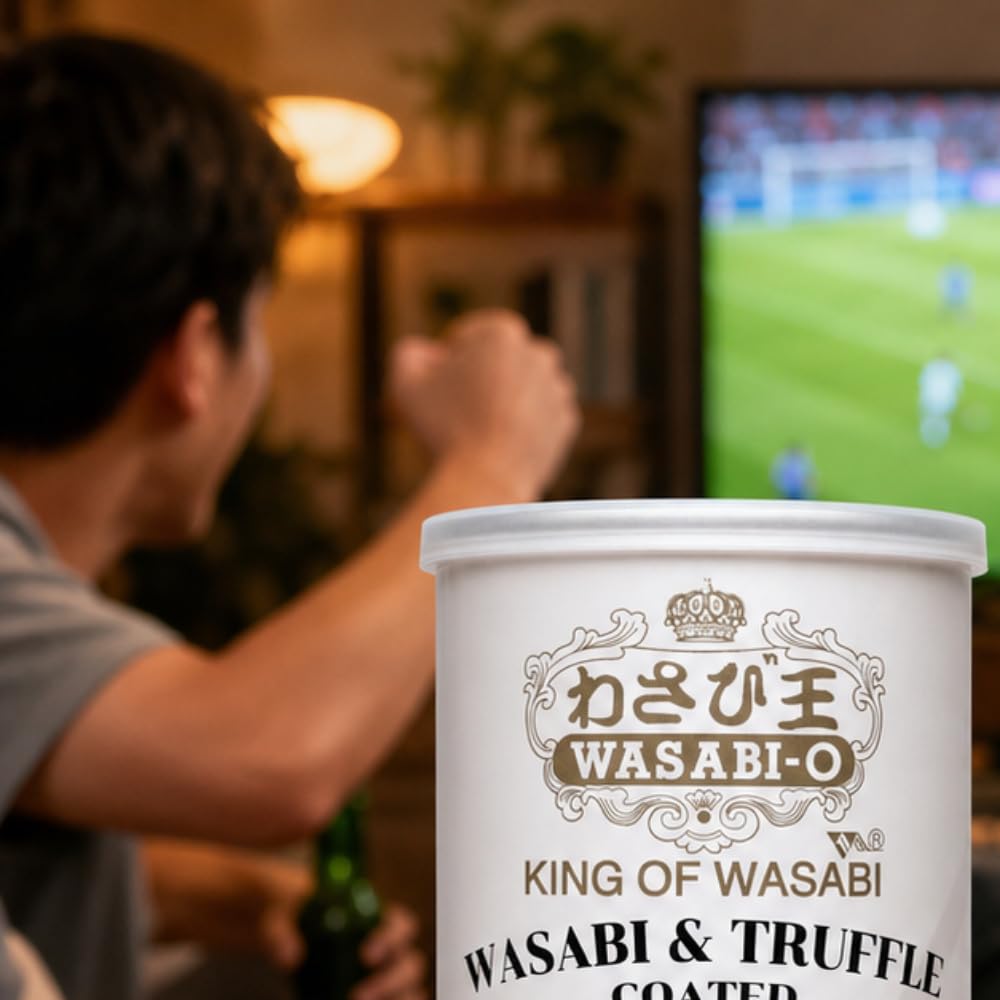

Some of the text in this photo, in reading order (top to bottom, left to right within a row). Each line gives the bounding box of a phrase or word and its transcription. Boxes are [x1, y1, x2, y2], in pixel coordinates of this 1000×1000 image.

[567, 652, 839, 731] わさび王
[570, 740, 842, 781] WASABI-O
[524, 860, 882, 898] KING OF WASABI
[464, 918, 945, 998] WASABI & TRUFFLE
